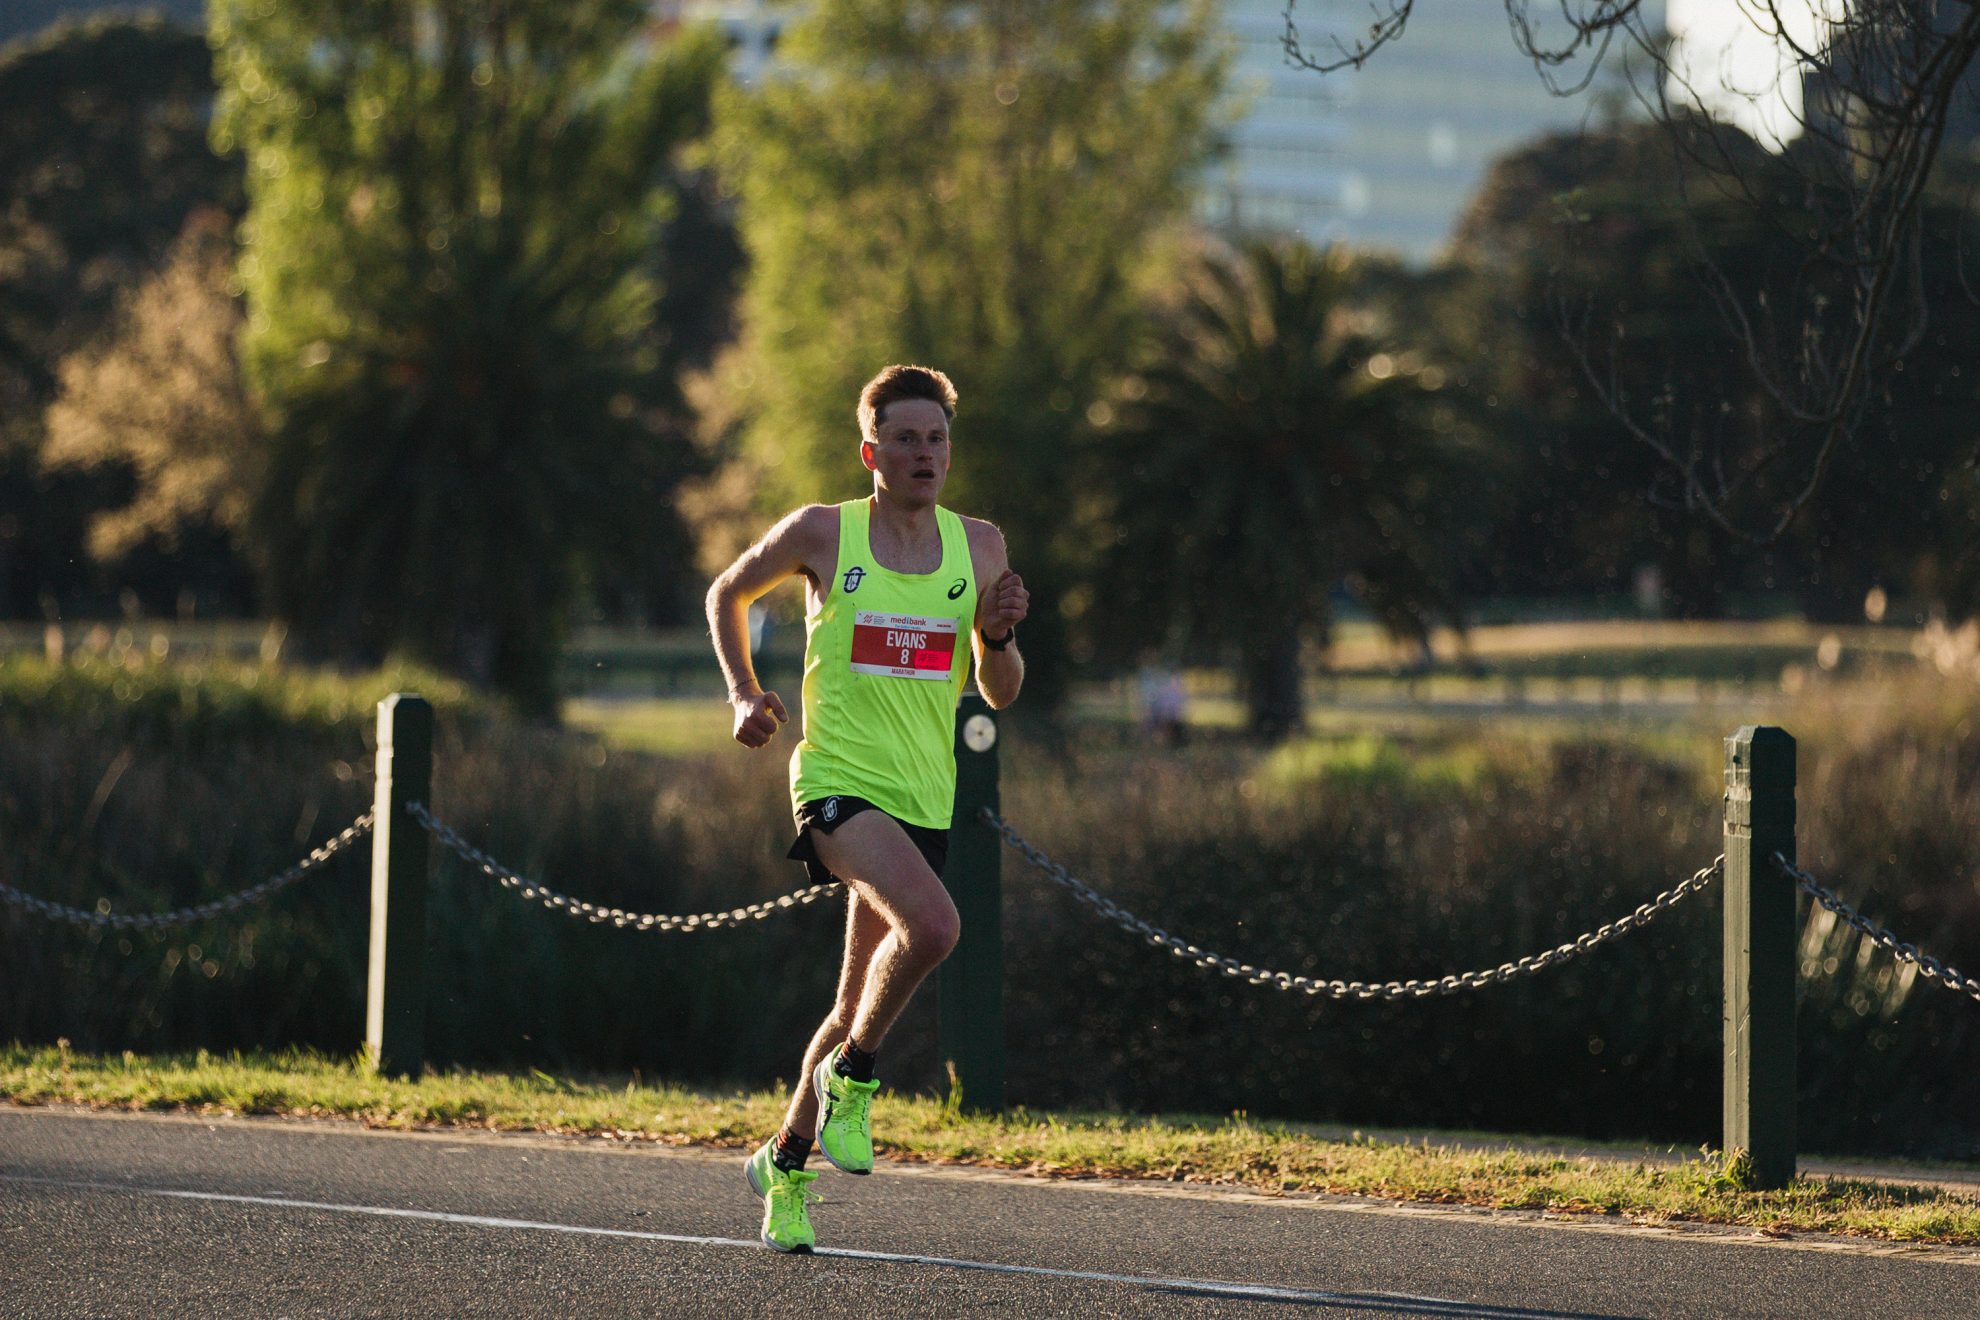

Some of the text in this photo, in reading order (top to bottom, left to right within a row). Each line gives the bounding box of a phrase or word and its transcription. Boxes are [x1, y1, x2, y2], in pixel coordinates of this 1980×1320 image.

[890, 616, 927, 626] medibank
[886, 630, 927, 650] EVANS
[900, 648, 910, 665] 8
